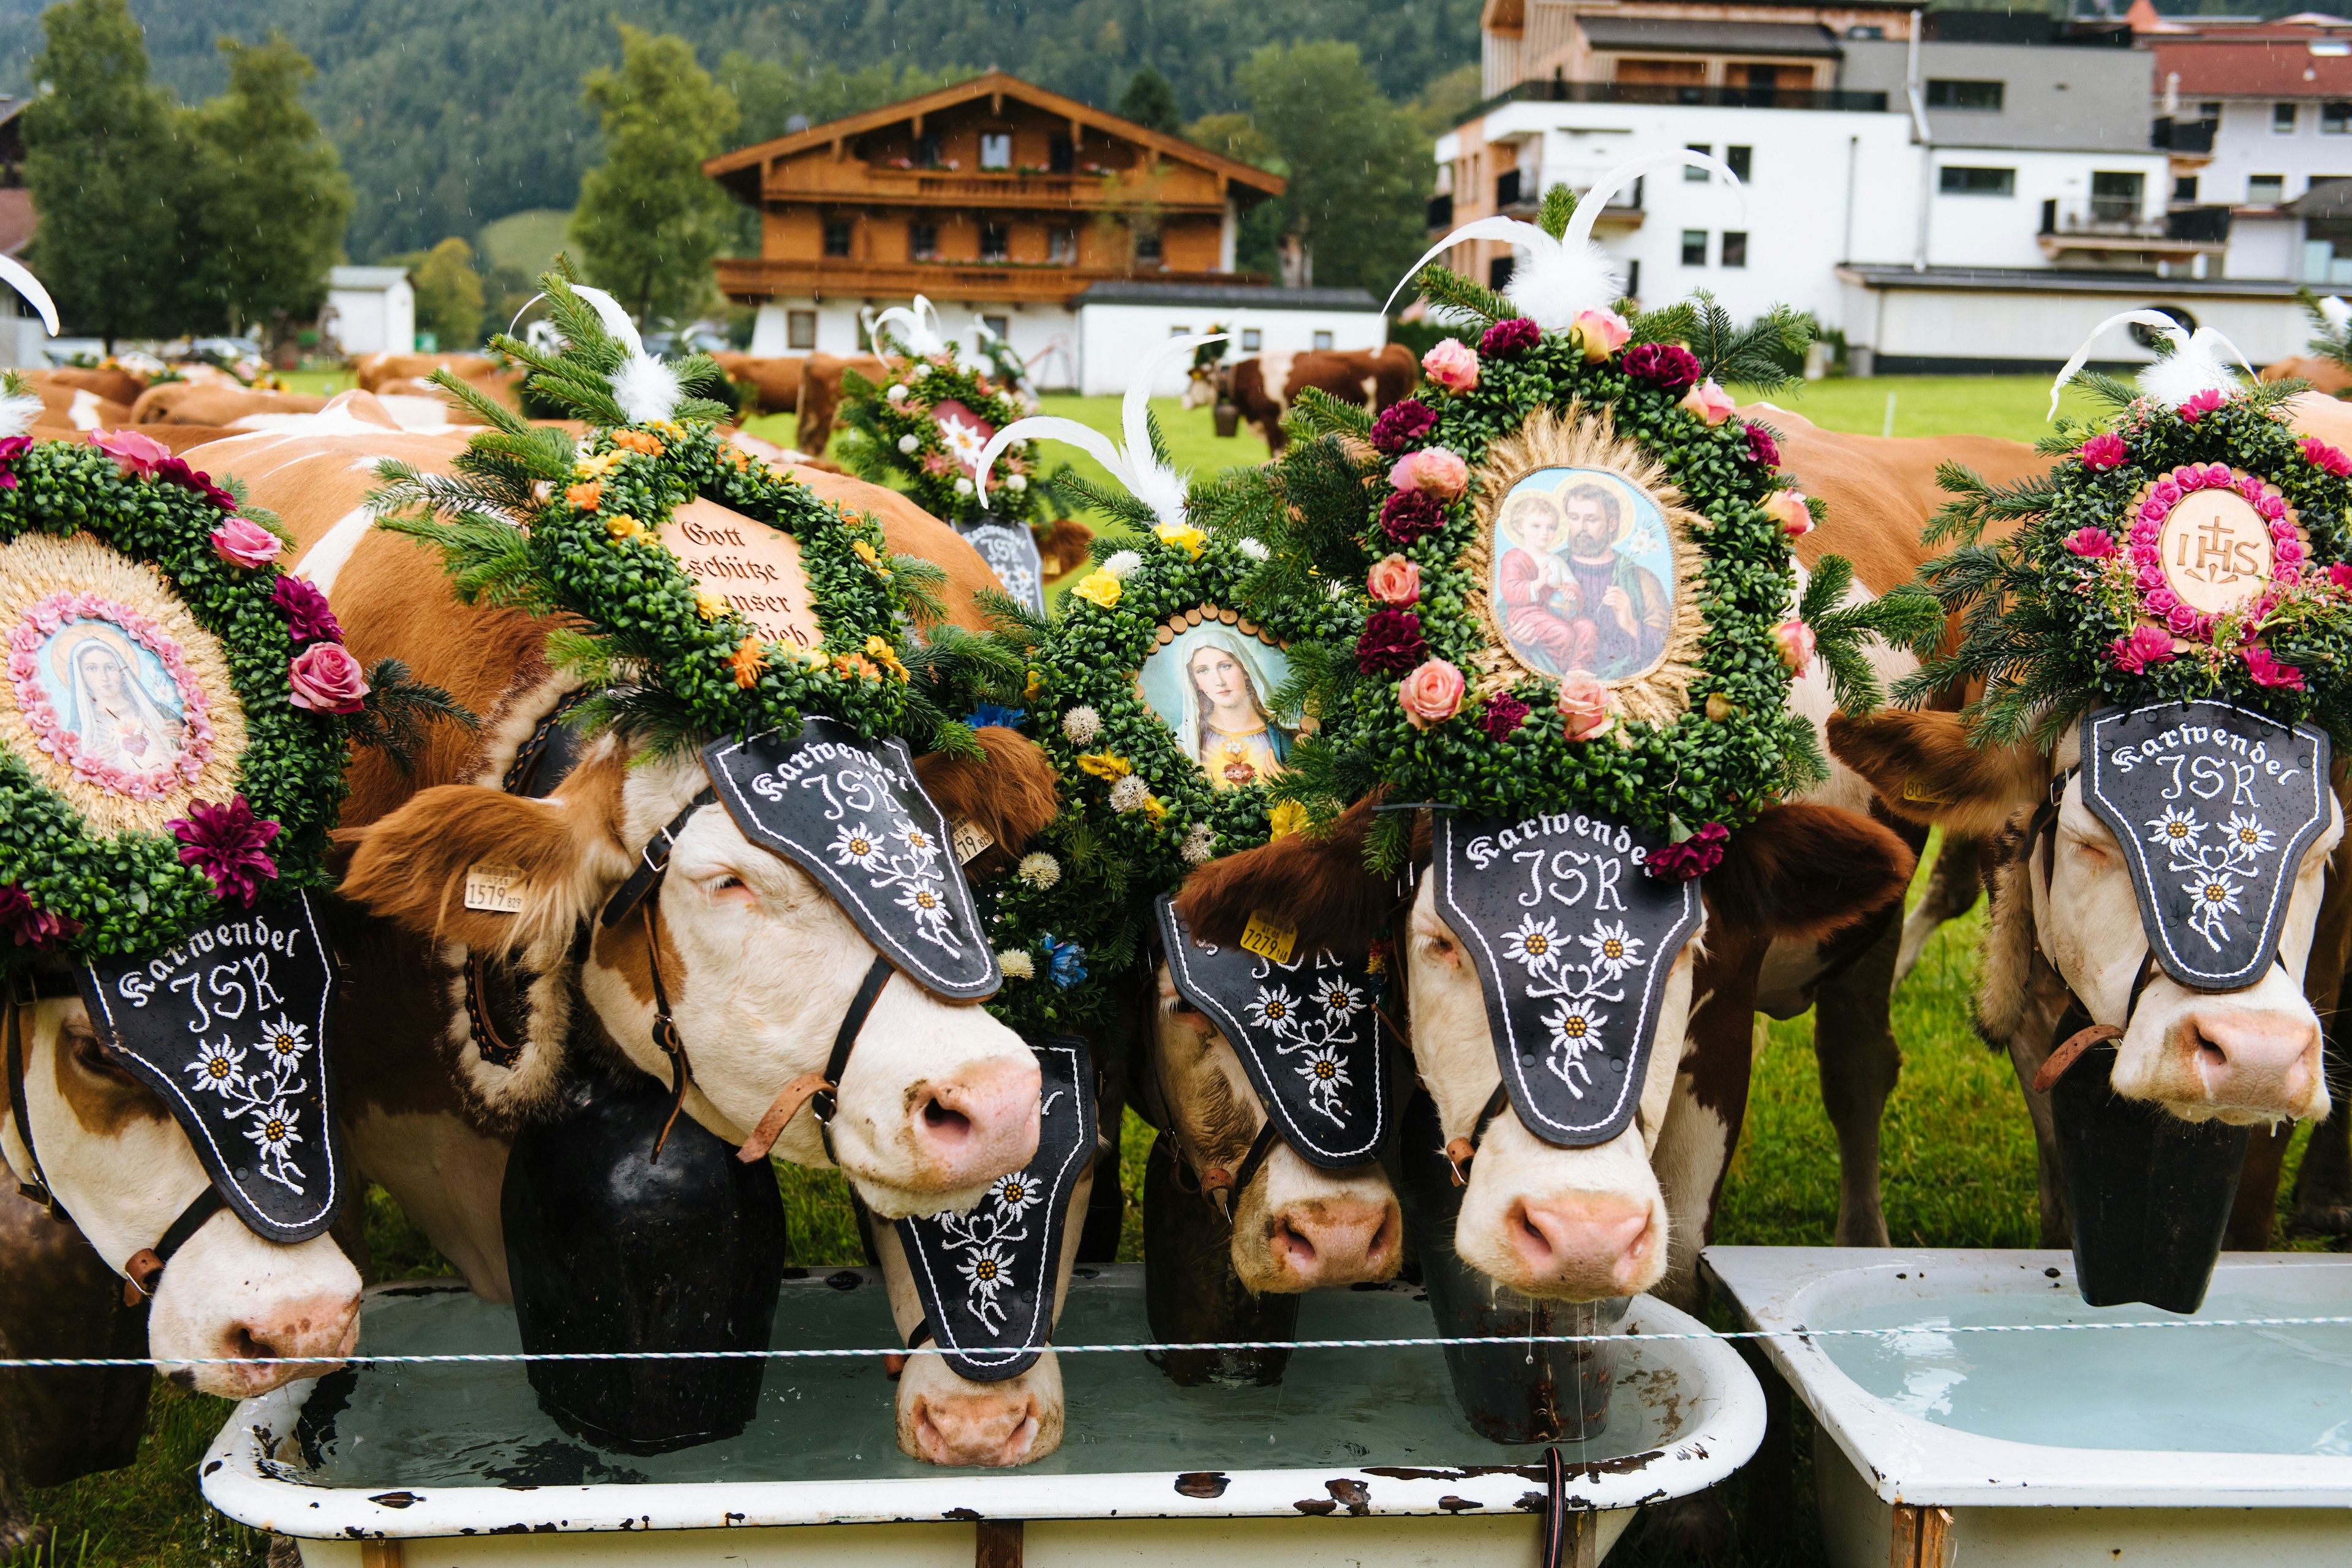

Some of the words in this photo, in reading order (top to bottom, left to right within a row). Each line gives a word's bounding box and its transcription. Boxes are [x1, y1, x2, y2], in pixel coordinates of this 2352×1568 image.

[681, 521, 745, 547] Gott
[2176, 529, 2261, 576] IHS
[751, 742, 909, 802] Karwendel
[2111, 723, 2301, 786] Karwendel
[977, 834, 991, 848] 829
[1466, 810, 1653, 878] Karwende
[467, 883, 506, 907] 1579
[118, 915, 301, 1008] Karwendel
[1243, 928, 1278, 956] 7279
[1275, 948, 1289, 962] 168
